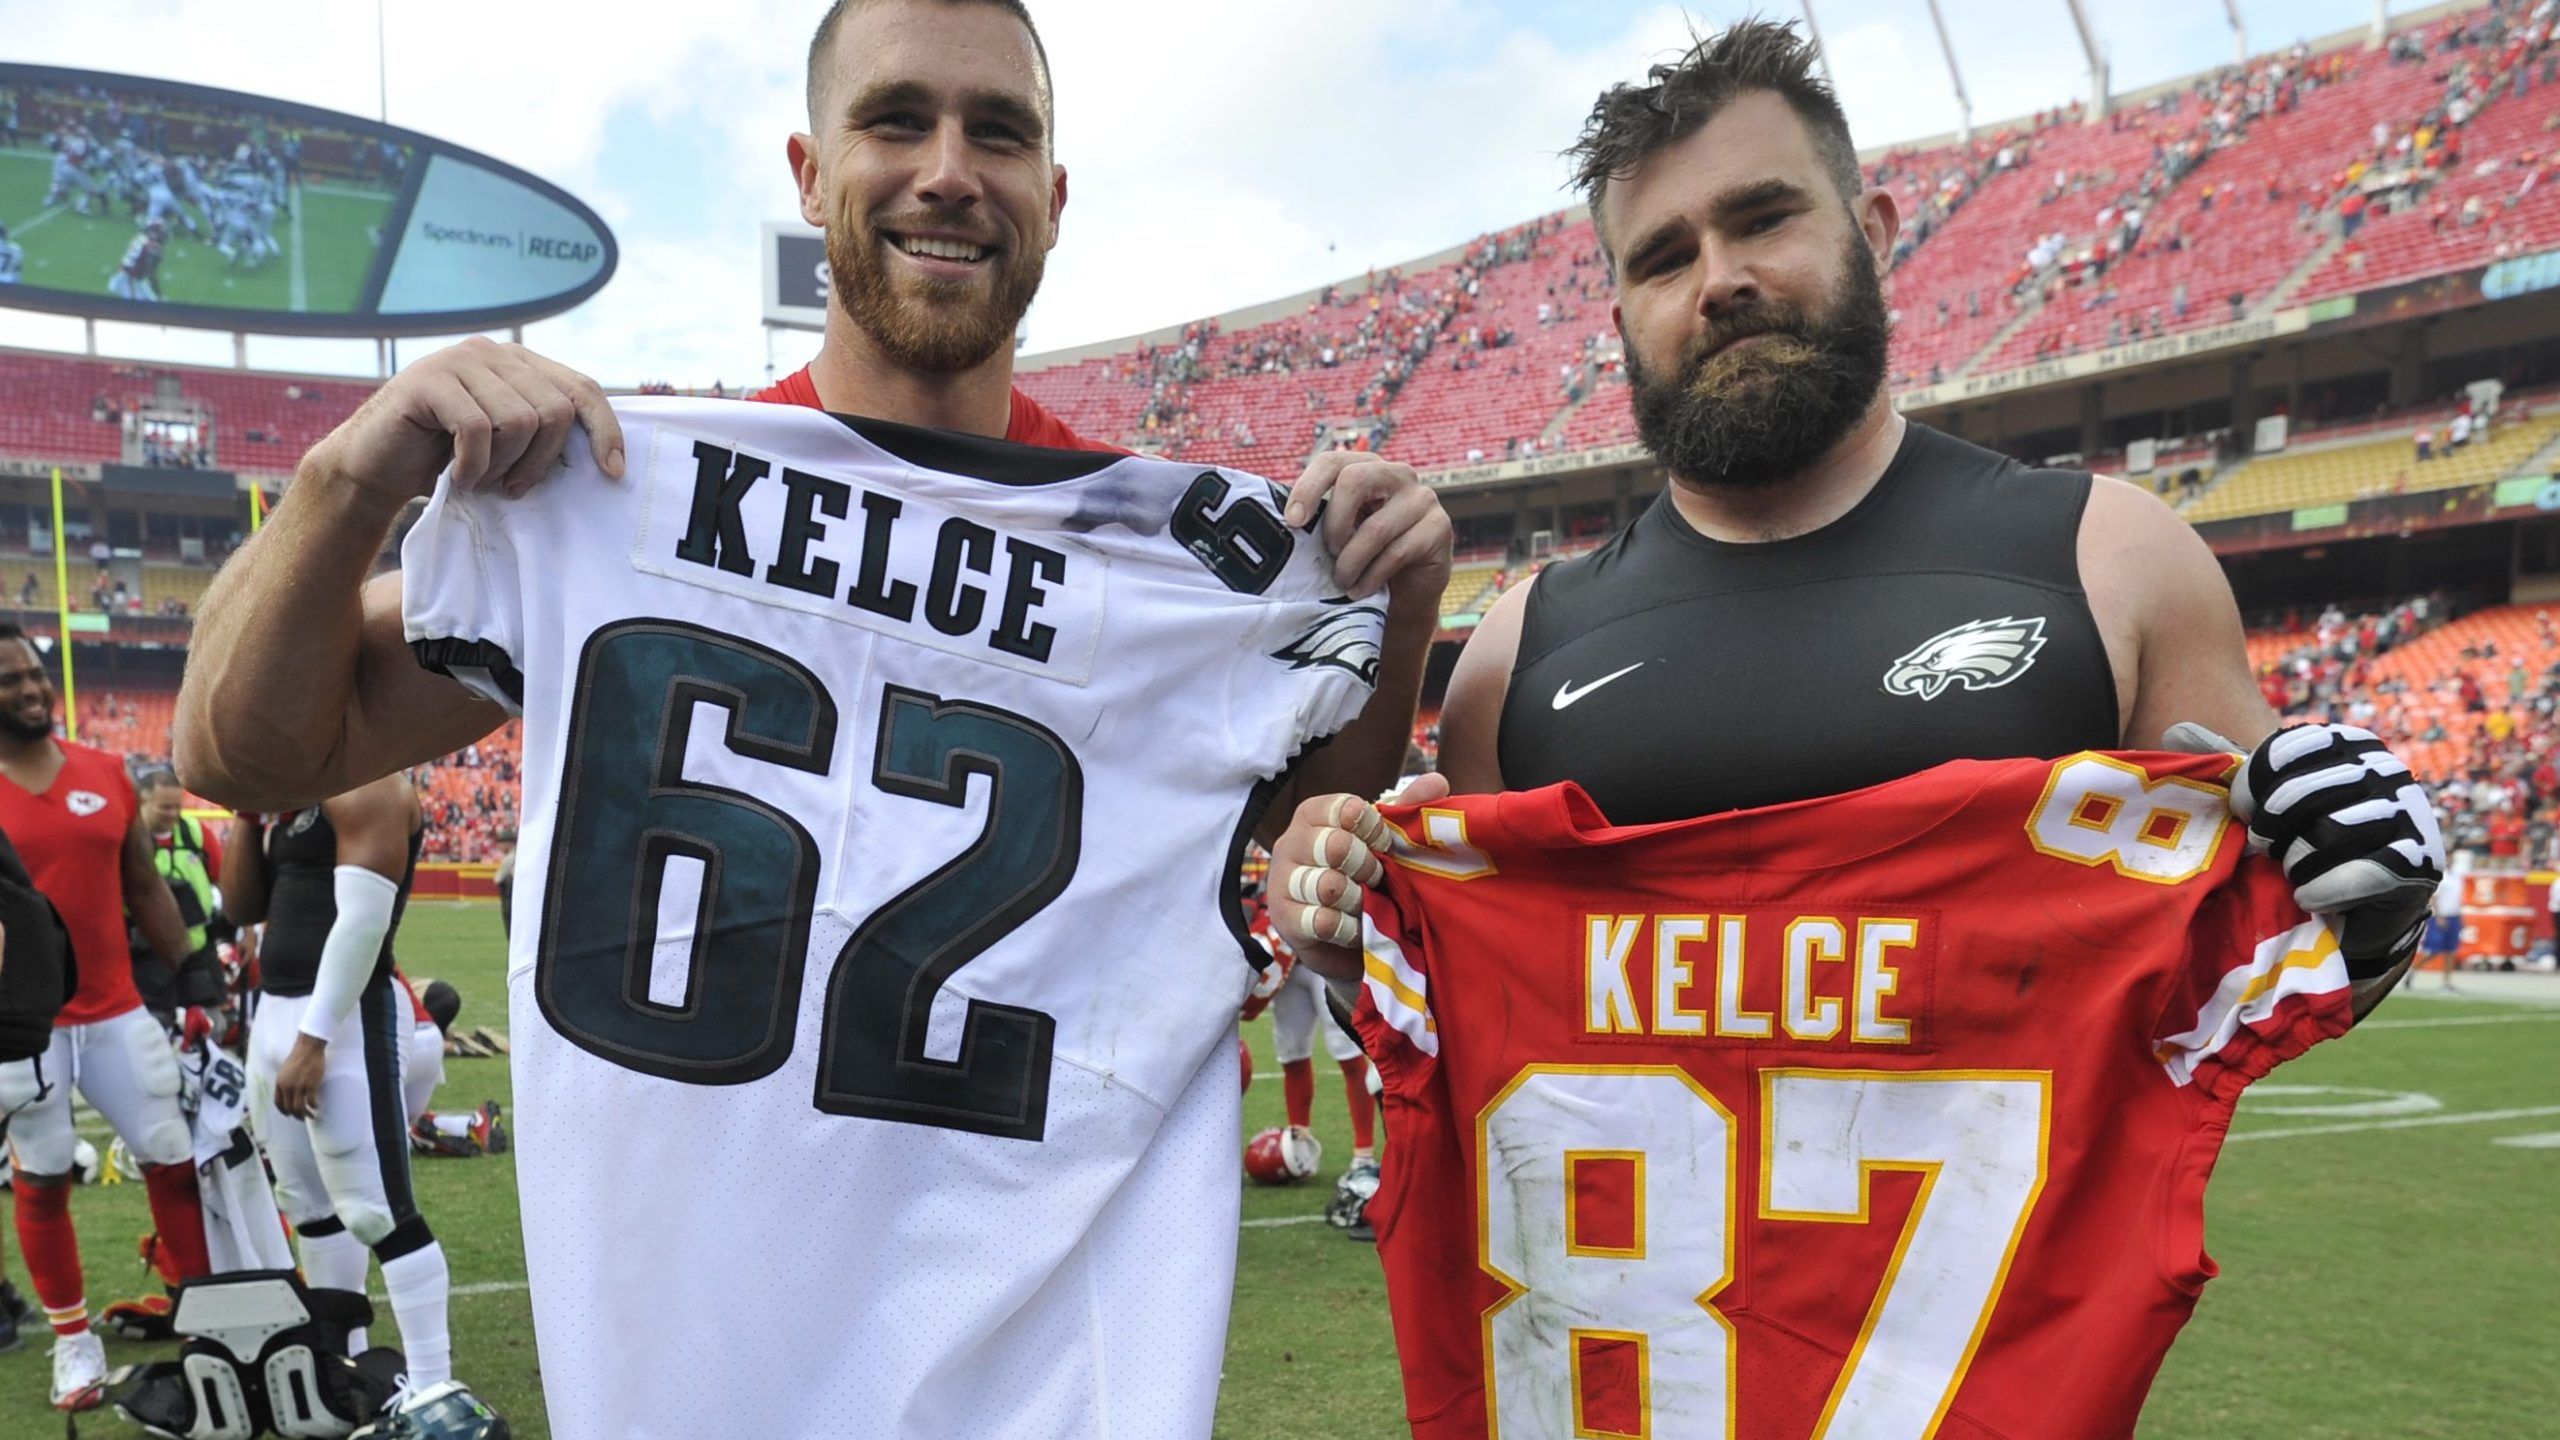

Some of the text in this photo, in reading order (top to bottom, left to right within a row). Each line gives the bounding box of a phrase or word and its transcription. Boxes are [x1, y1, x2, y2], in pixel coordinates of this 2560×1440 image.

[423, 223, 598, 262] Spectrum RECAP
[676, 440, 1066, 665] KELCE
[1170, 471, 1328, 596] 6
[535, 617, 1084, 1142] 62
[2024, 750, 2232, 886] 8
[1585, 912, 1919, 1046] KELCE
[205, 1059, 246, 1108] 58
[1476, 1063, 2053, 1440] 87
